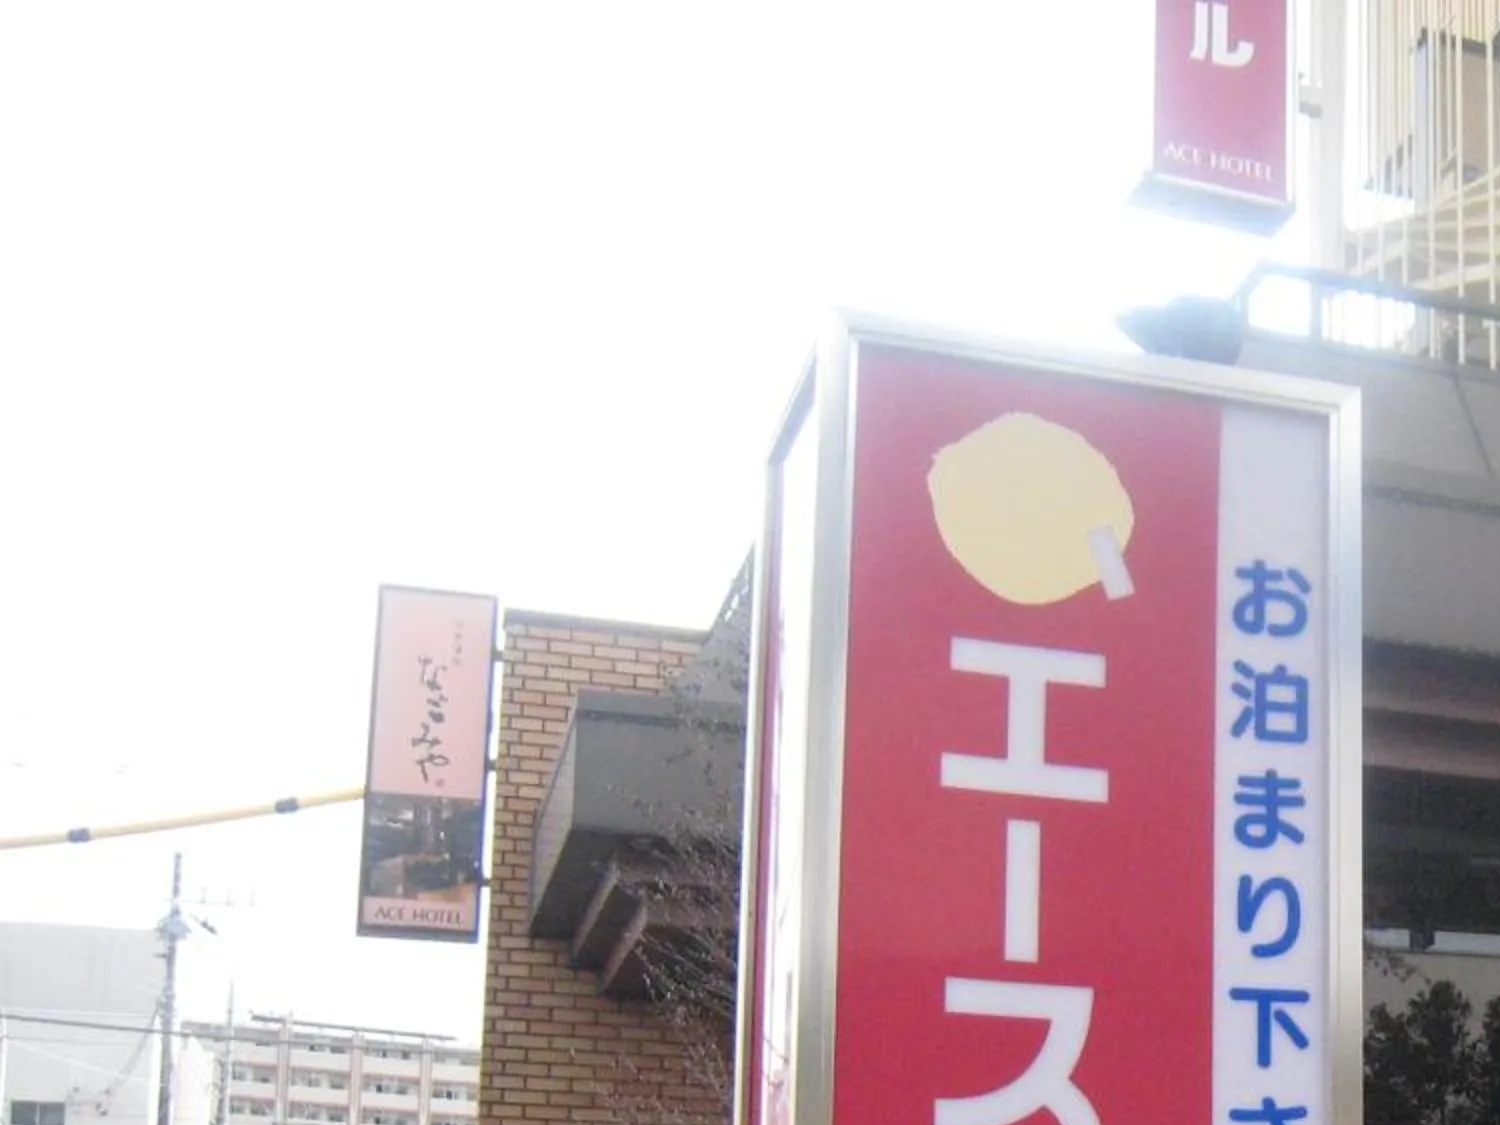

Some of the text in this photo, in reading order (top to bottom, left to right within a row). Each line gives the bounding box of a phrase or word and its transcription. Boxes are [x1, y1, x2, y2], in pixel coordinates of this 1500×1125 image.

[1163, 141, 1273, 182] ACE HOTEL
[374, 905, 464, 926] ACE HOTEL
